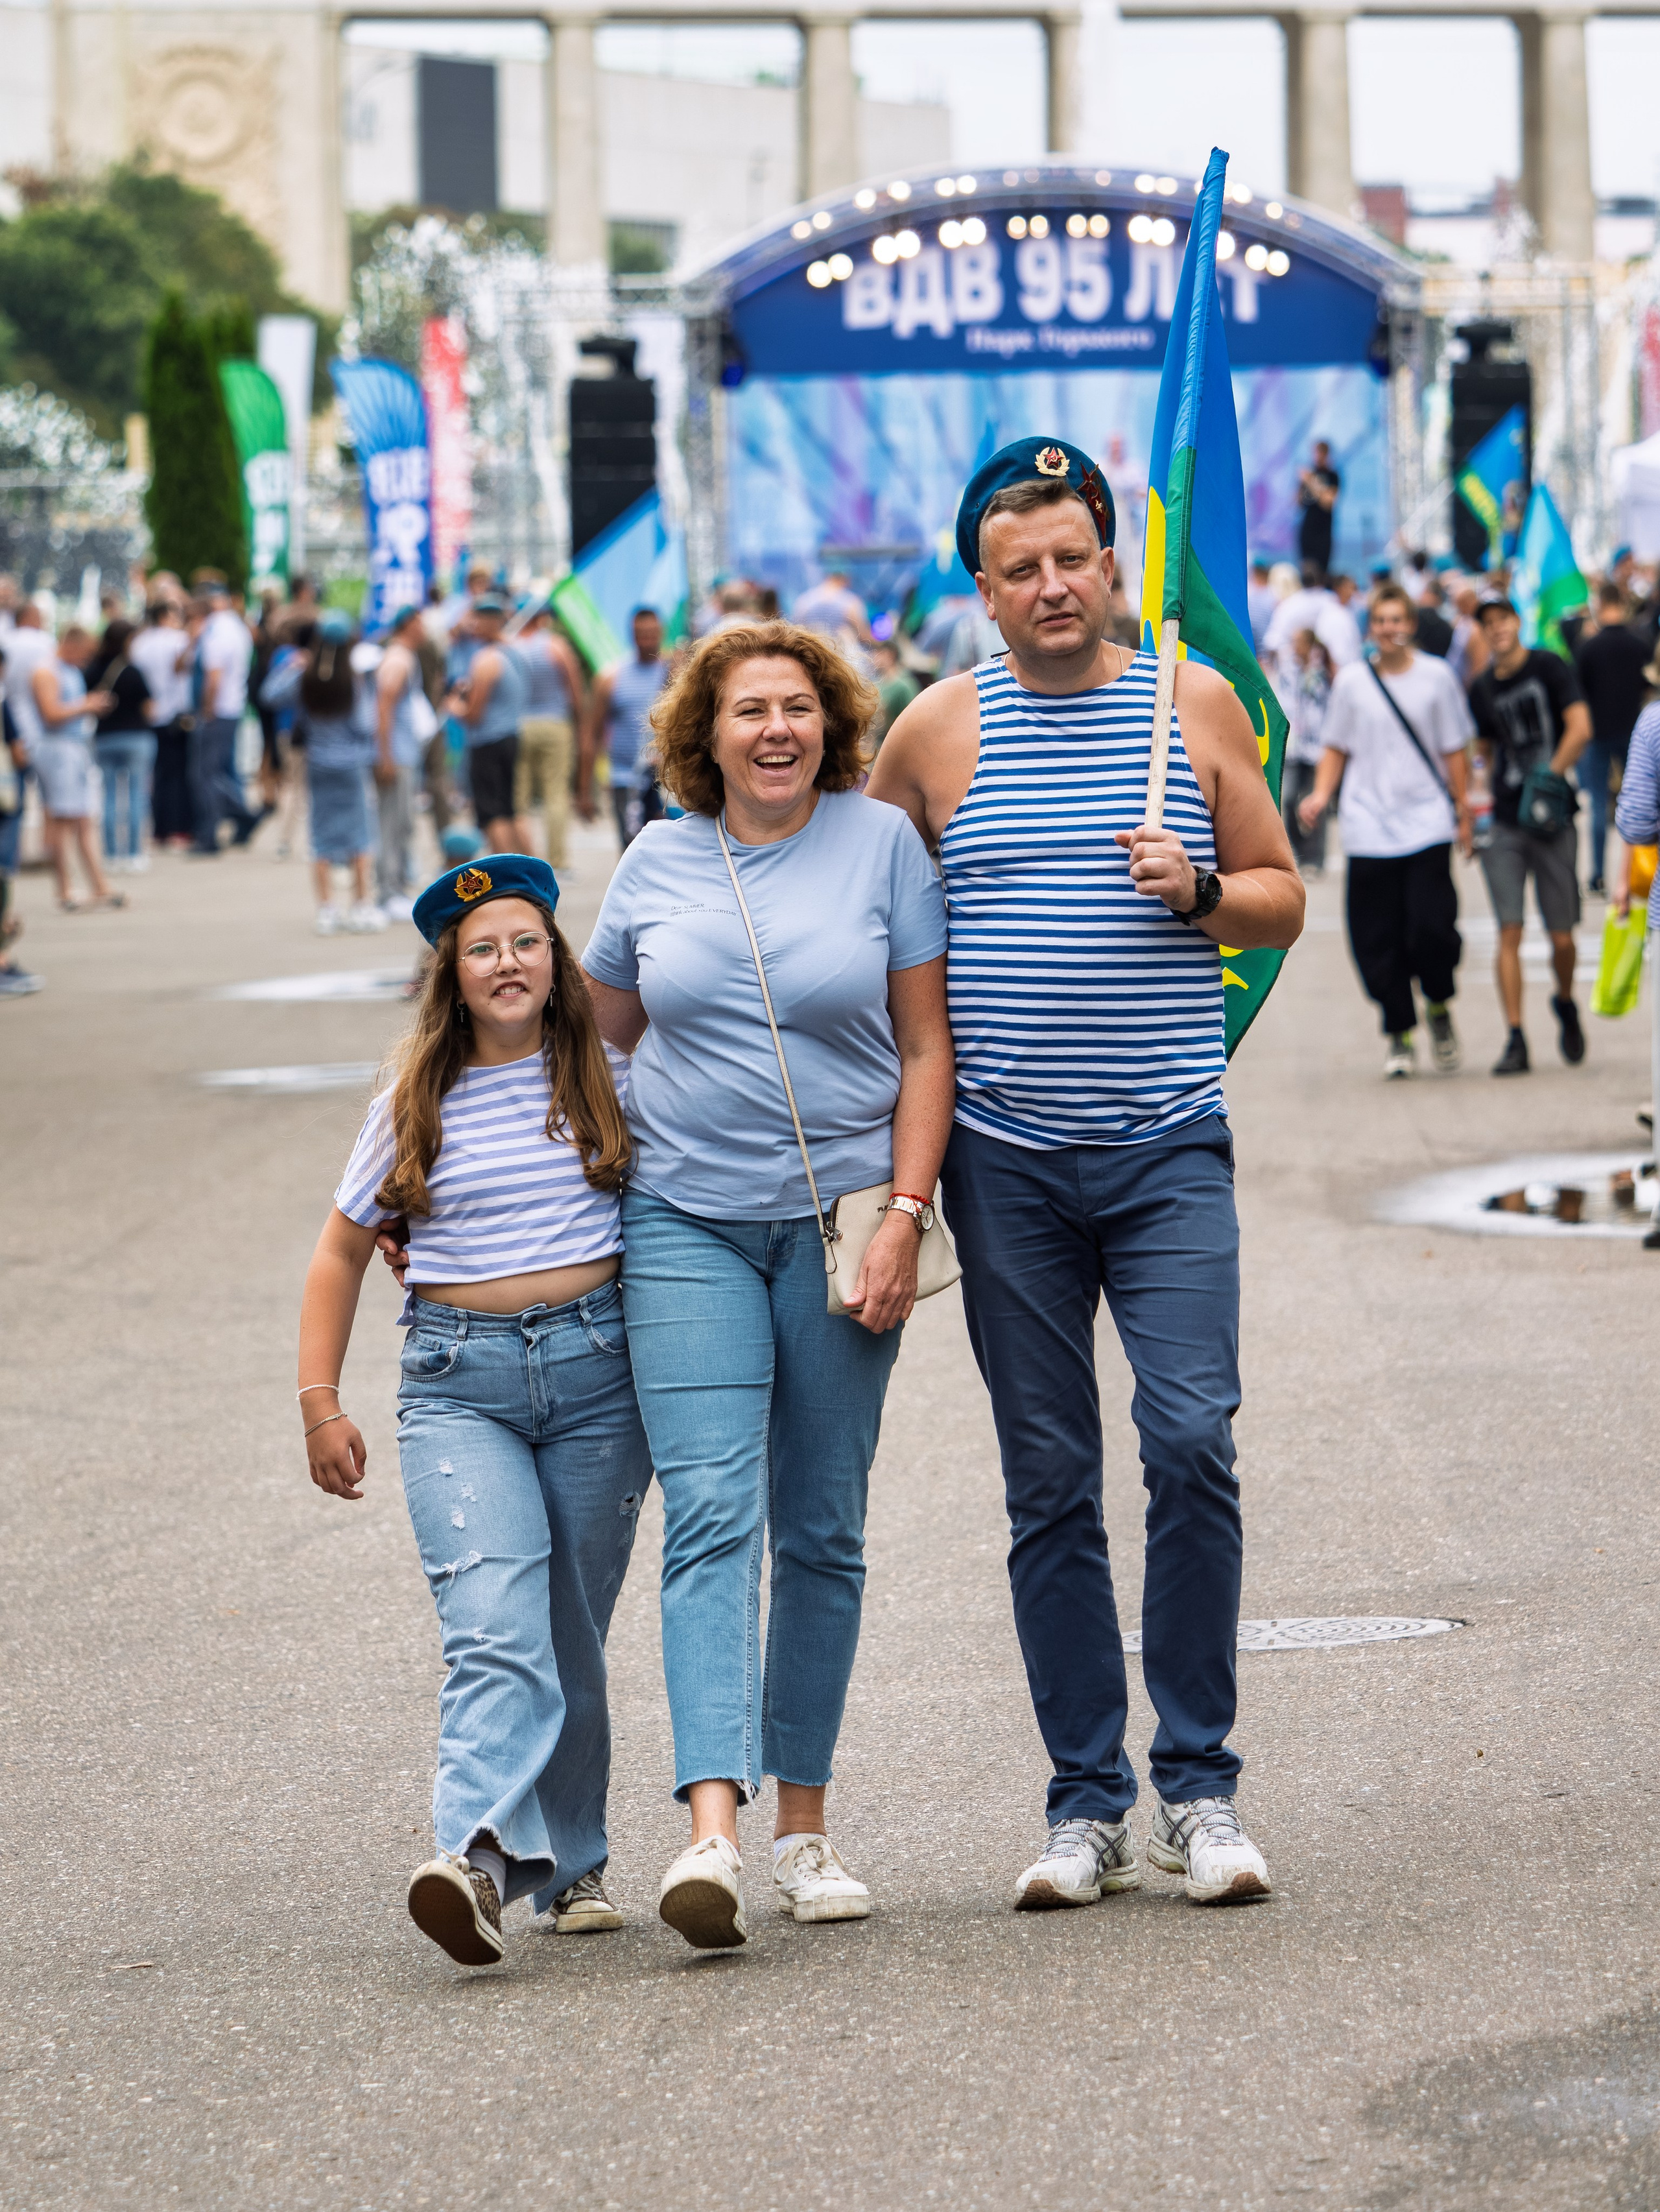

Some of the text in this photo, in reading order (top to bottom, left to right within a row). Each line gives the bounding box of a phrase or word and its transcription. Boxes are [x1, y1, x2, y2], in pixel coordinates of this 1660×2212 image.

[843, 236, 1265, 339] ВДВ 95 ЛТ
